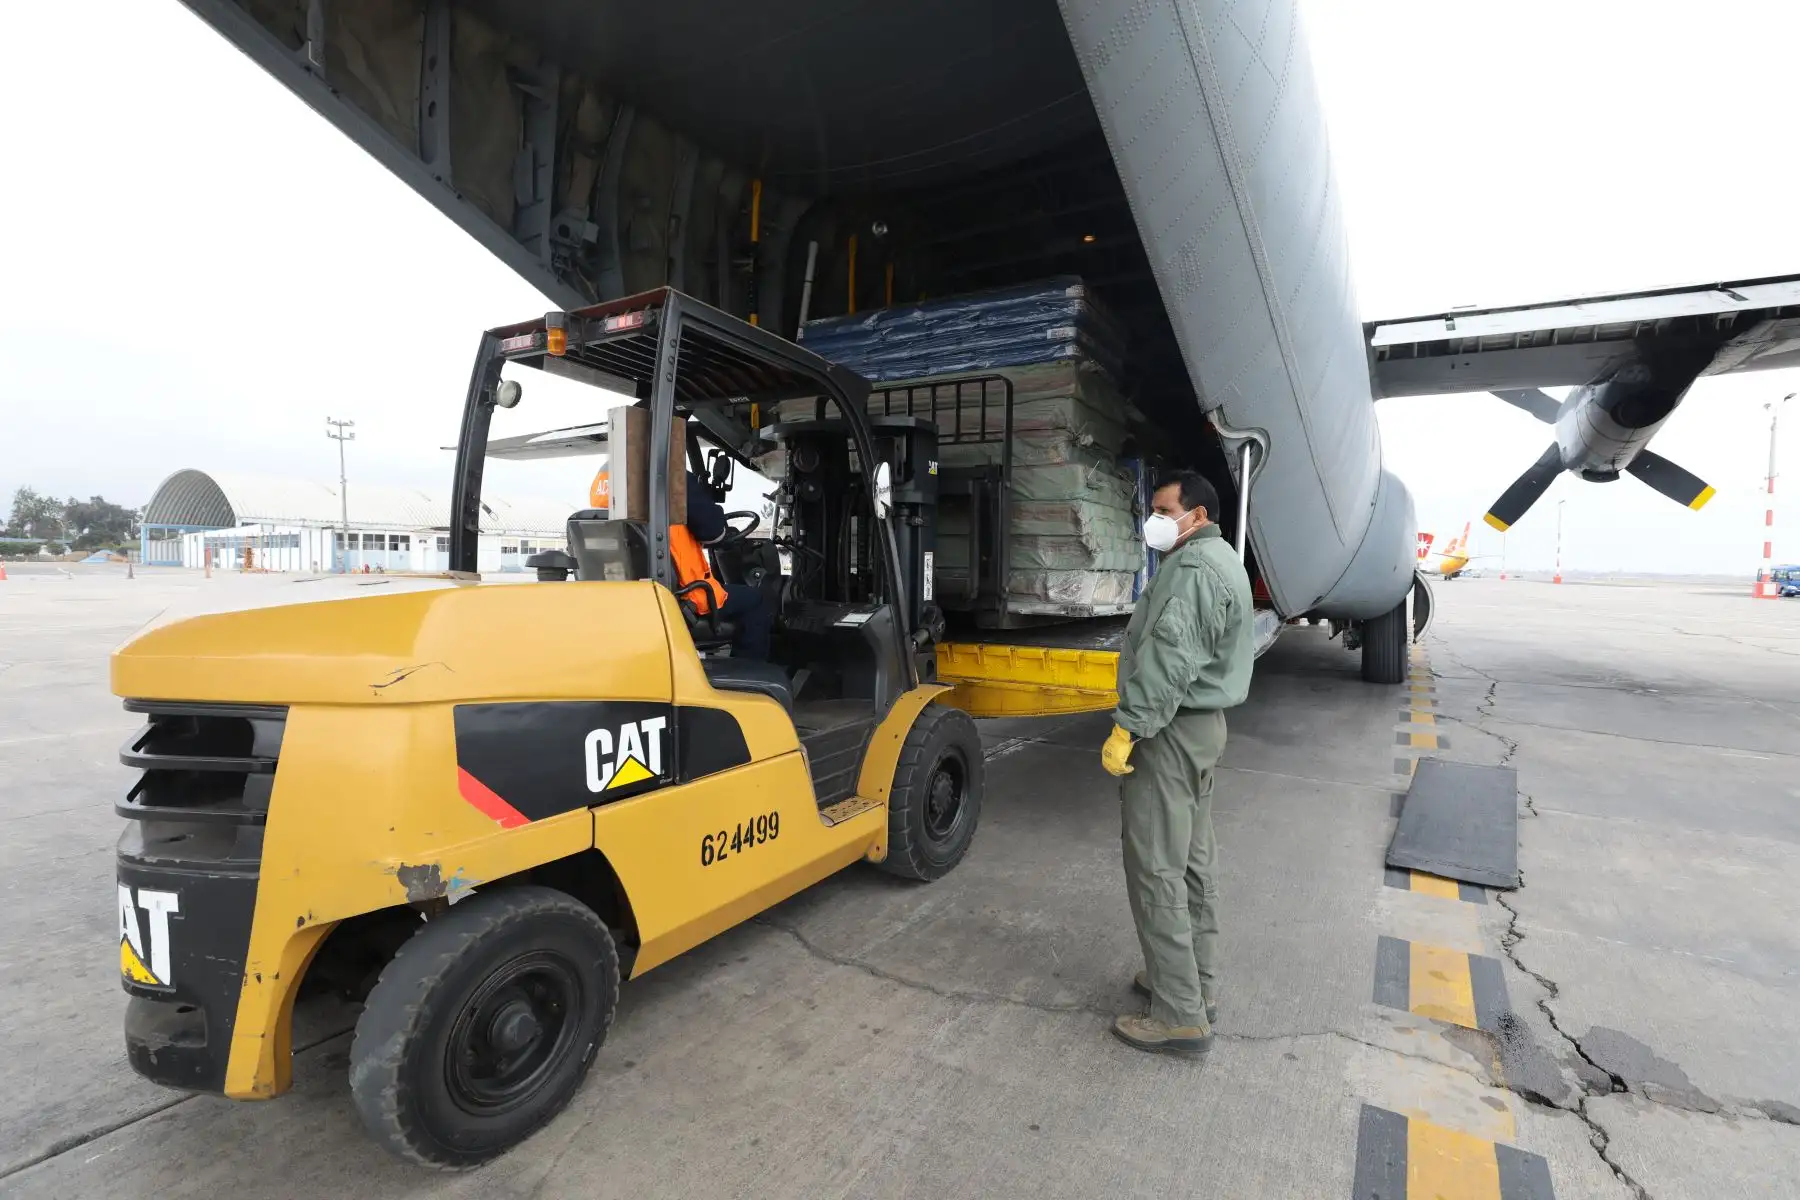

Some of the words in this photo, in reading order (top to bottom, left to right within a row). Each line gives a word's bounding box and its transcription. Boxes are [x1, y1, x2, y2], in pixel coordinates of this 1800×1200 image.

[585, 716, 666, 793] CAT
[701, 811, 779, 866] 624499
[118, 884, 180, 986] AT
